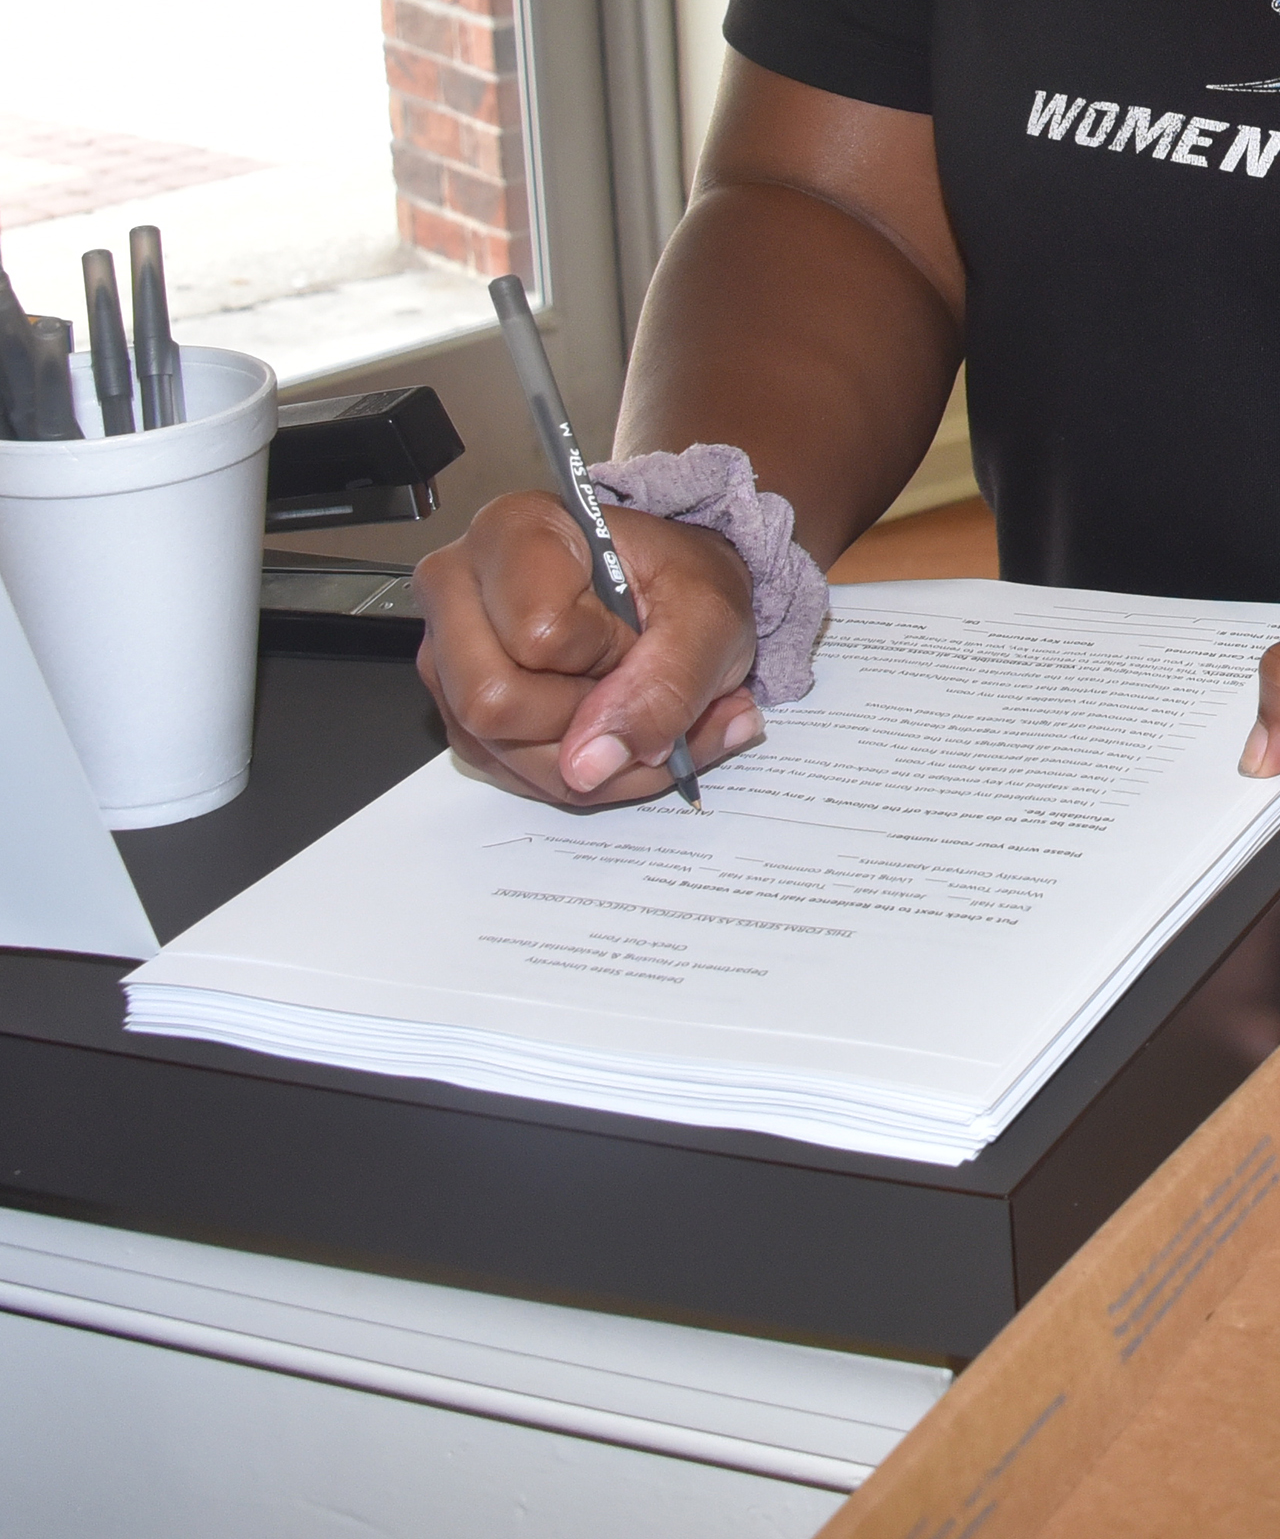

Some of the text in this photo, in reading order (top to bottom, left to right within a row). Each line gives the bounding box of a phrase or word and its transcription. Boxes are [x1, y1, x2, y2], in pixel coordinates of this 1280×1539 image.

[570, 448, 588, 477] Stic
[579, 483, 611, 539] Round
[606, 553, 625, 582] BIC
[845, 619, 928, 631] Never Received
[987, 633, 1039, 643] Returned
[895, 758, 926, 766] room
[1024, 769, 1078, 778] removed
[1080, 775, 1109, 783] have
[748, 788, 781, 797] items
[782, 792, 805, 800] any
[823, 797, 880, 810] following.
[675, 806, 699, 815] (B)
[695, 807, 715, 817] (A)
[924, 810, 959, 818] check
[1024, 809, 1115, 823] refundable fee.
[1068, 822, 1108, 832] Please
[544, 836, 714, 861] University Village Apartments
[941, 839, 975, 847] room
[1007, 845, 1040, 853] write
[1043, 849, 1083, 858] Please
[573, 854, 693, 873] Warren Franklin Hall
[763, 862, 914, 884] Living Learning commons
[859, 859, 1058, 886] University Courtyard Apartments
[678, 880, 730, 893] vacating
[718, 872, 826, 890] Tubman Laws Hall
[755, 891, 780, 899] you
[853, 887, 928, 900] Jenkins Hall
[948, 883, 1044, 899] Wynder Towers
[779, 895, 807, 903] Hall
[808, 898, 872, 909] Residence
[874, 904, 895, 912] the
[969, 900, 1033, 912] Evers Hall
[492, 888, 856, 938] THIS FORM SERVES AS MY OFFICIAL CHECK-OUT DOCUMENT
[914, 909, 944, 917] next
[946, 912, 983, 922] check
[996, 917, 1019, 926] Put
[478, 935, 539, 948] Education
[589, 933, 688, 952] Check-Out Form
[538, 942, 609, 958] Residential
[623, 953, 675, 967] Housing
[525, 956, 685, 984] Delaware State University
[691, 963, 769, 977] Department
